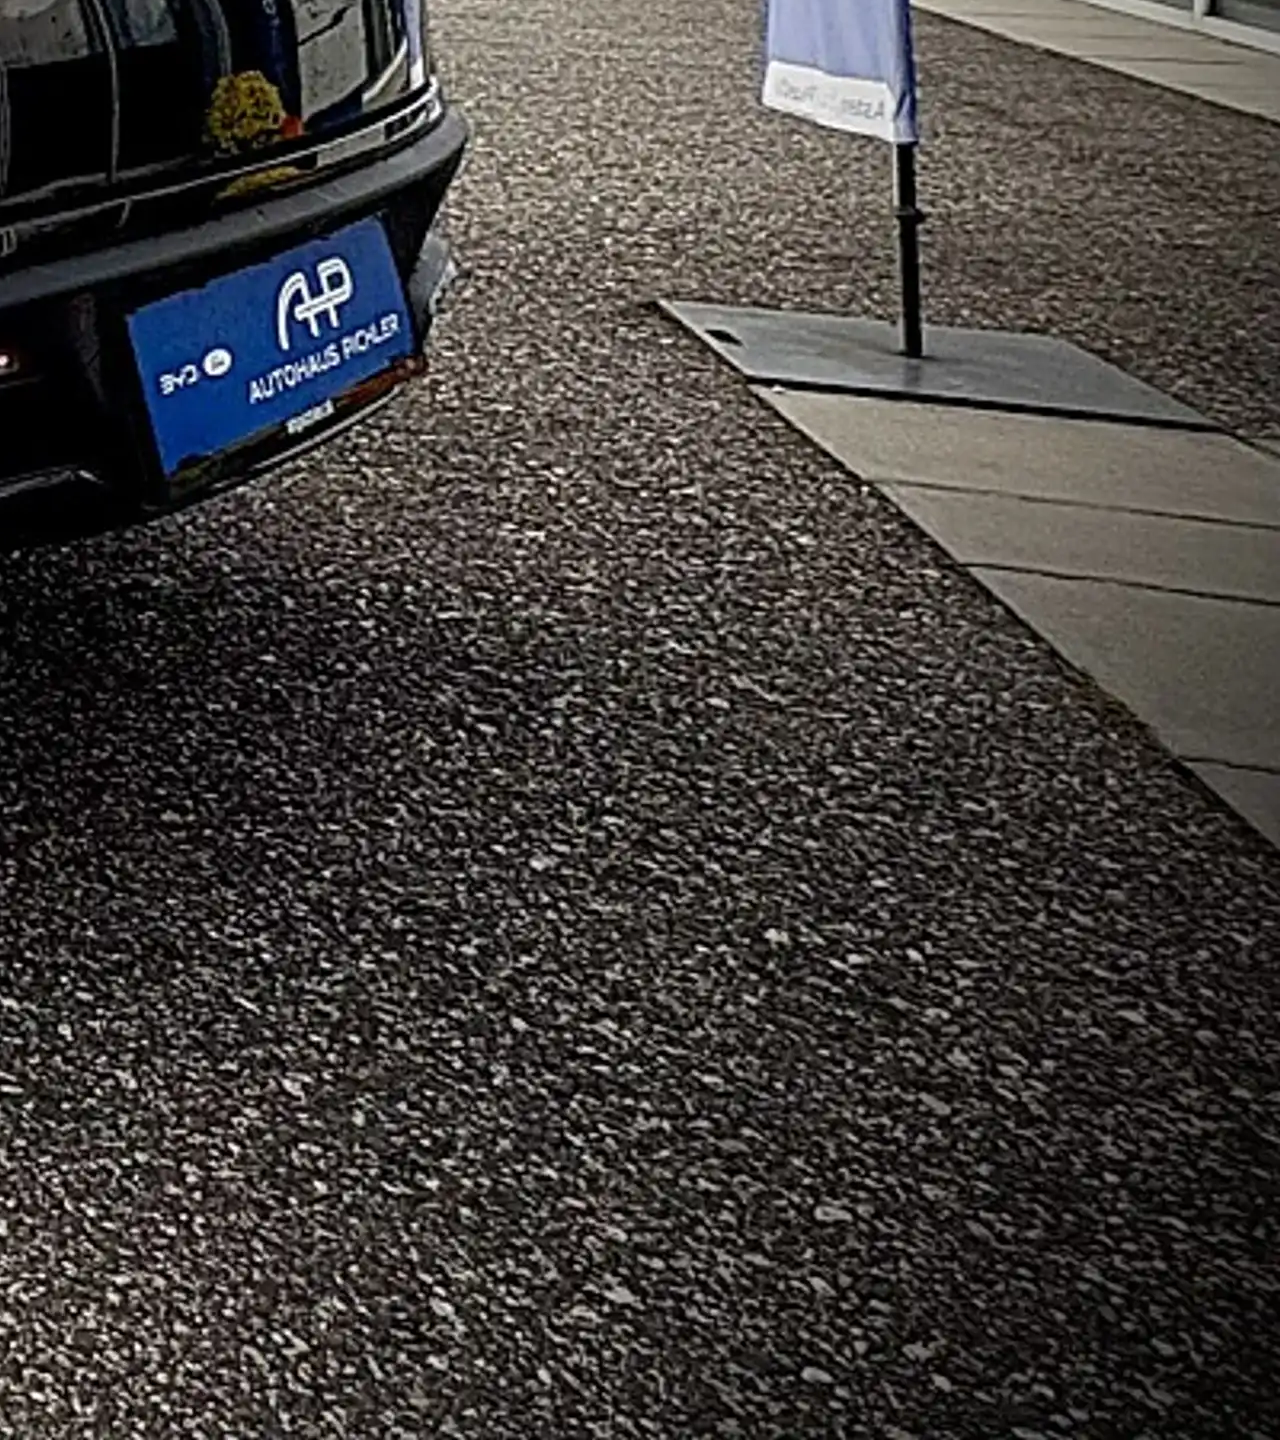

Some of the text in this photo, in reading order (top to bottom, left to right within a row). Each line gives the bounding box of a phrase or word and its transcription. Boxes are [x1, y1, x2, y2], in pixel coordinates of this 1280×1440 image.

[159, 364, 200, 396] BYD
[249, 343, 341, 405] AUTOHAUS
[341, 313, 400, 360] PICHLER
